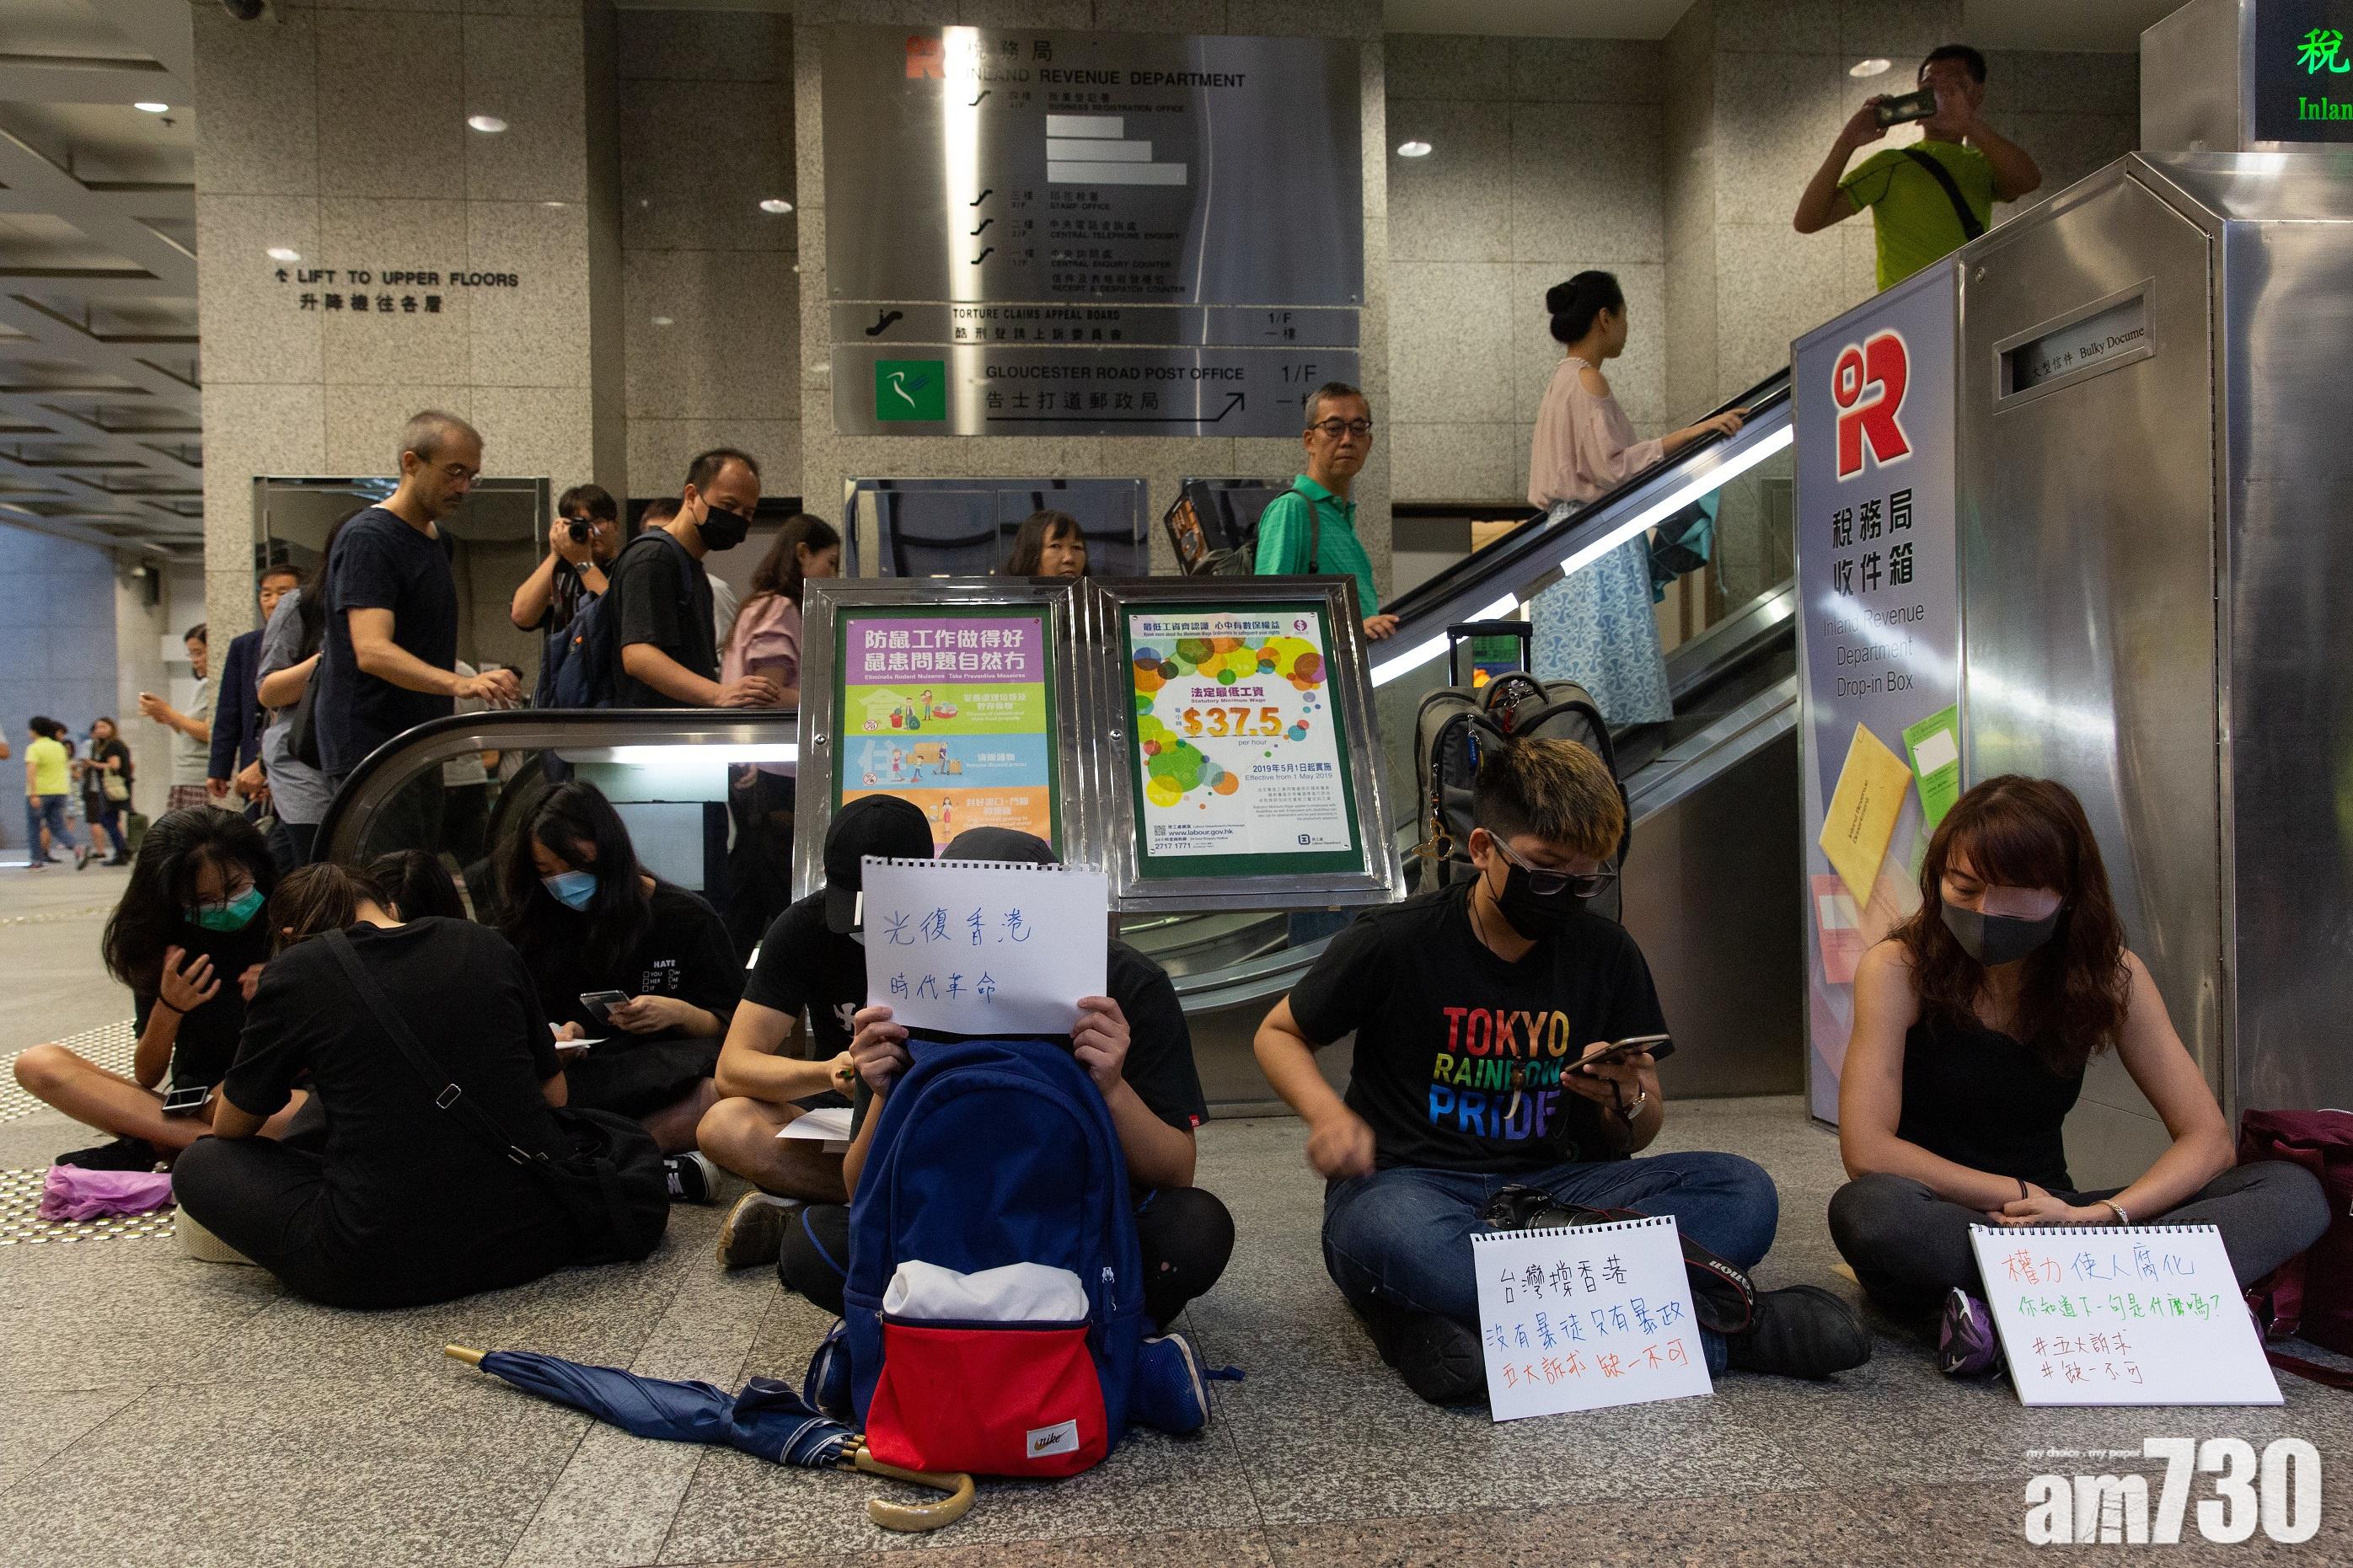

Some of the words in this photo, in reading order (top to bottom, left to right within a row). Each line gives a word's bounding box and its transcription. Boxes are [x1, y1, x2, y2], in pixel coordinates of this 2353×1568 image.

[2297, 28, 2350, 74] 稅
[1039, 68, 1120, 85] REVENUE
[1130, 72, 1246, 88] DEPARTMENT
[297, 270, 335, 283] LIFT
[347, 270, 372, 284] TO
[383, 271, 439, 285] UPPER
[449, 272, 518, 286] FLOORS
[300, 293, 442, 313] 升降機往各層
[953, 308, 999, 319] TORTURE
[1004, 309, 1040, 319] CLAIMS
[1046, 309, 1081, 320] APPEAL
[1087, 310, 1120, 320] BOARD
[1269, 313, 1291, 324] 1/F
[2079, 341, 2104, 359] Bulky
[986, 366, 1091, 379] GLOUCESTER
[1096, 367, 1140, 380] ROAD
[1145, 367, 1185, 380] POST
[1190, 367, 1244, 380] OFFICE
[1281, 365, 1316, 383] 1/F
[2032, 352, 2073, 377] 大型信件
[986, 391, 1160, 410] 告士打道郵政局
[1832, 488, 1912, 549] 稅務局
[1833, 542, 1913, 597] 收件箱
[1144, 622, 1209, 631] 最低工資齊認識
[1214, 621, 1279, 630] 心中有數保權益
[1824, 614, 1859, 637] Inland
[1864, 604, 1924, 630] Revenue
[866, 629, 1024, 649] 防鼠工作做得好
[1837, 636, 1913, 668] Department
[865, 650, 1025, 672] 鼠患問題自然冇
[1191, 687, 1264, 698] 法定最低工資
[1837, 674, 1882, 698] Drop-in
[1887, 671, 1914, 692] Box
[1182, 707, 1283, 738] $37.5
[1252, 763, 1332, 773] 2019年5月1日起實施
[883, 907, 1031, 945] 光復香港
[654, 960, 675, 968] HATE
[891, 971, 996, 1003] 時代革命
[1444, 1007, 1569, 1057] TOKYO
[2002, 1248, 2061, 1285] 權力
[2071, 1242, 2195, 1282] 使人腐化
[1500, 1254, 1627, 1304] 台灣撐香港
[1709, 1260, 1753, 1306] Canon
[2018, 1292, 2220, 1321] 你知道下一句是什麼嗎?
[1486, 1298, 1686, 1351] 沒有暴徒只有暴政
[2032, 1329, 2131, 1357] #五大訴求
[1503, 1350, 1587, 1389] 五大訴求
[1597, 1339, 1690, 1378] 缺一不可
[1039, 1432, 1061, 1446] nike
